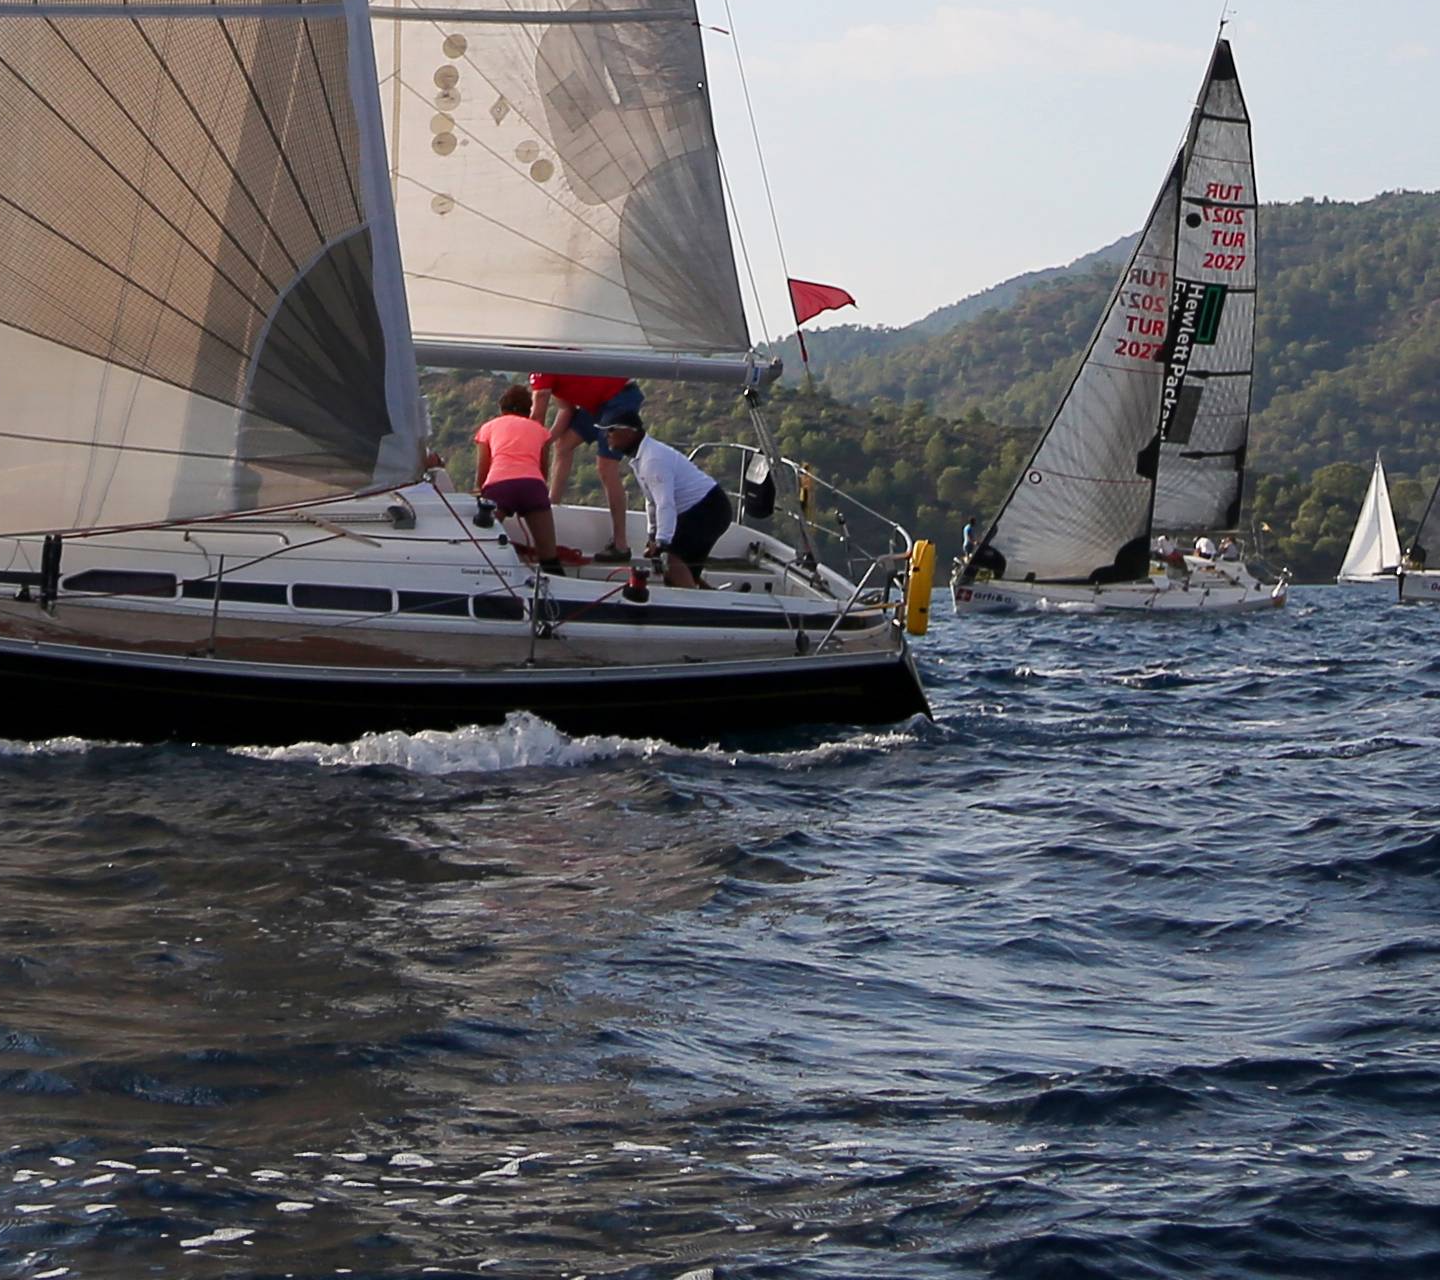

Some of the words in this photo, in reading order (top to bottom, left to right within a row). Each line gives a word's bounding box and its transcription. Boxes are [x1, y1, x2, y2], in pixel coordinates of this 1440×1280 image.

[1211, 230, 1246, 248] TUR
[1202, 253, 1246, 271] 2027
[1126, 316, 1165, 337] TUR
[1173, 283, 1206, 361] Hewlett
